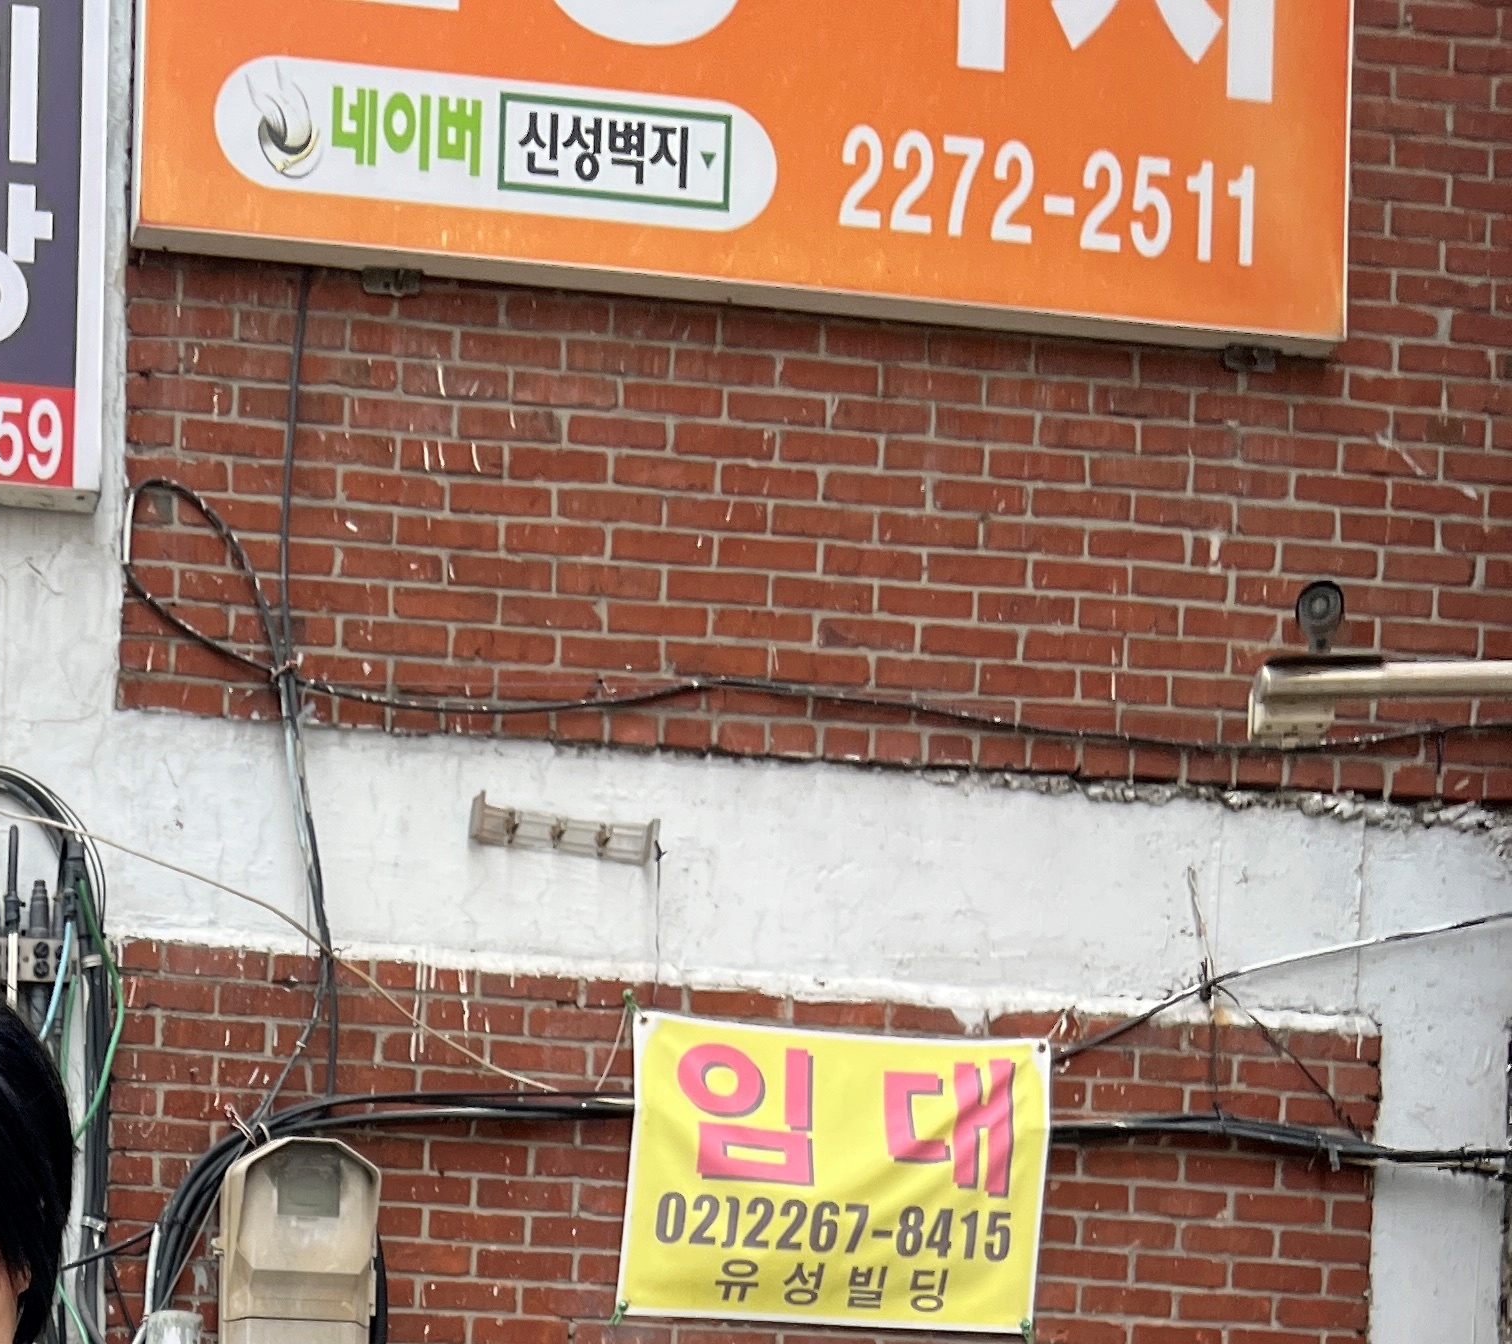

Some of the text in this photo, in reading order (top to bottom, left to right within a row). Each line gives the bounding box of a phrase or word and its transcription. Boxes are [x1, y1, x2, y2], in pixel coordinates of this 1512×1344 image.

[331, 84, 482, 177] 네이버
[518, 111, 688, 189] 신성벽지
[838, 124, 1256, 267] 2272-2511
[655, 1191, 1013, 1263] 02)2267-8415
[715, 1258, 950, 1313] 유성빌딩
